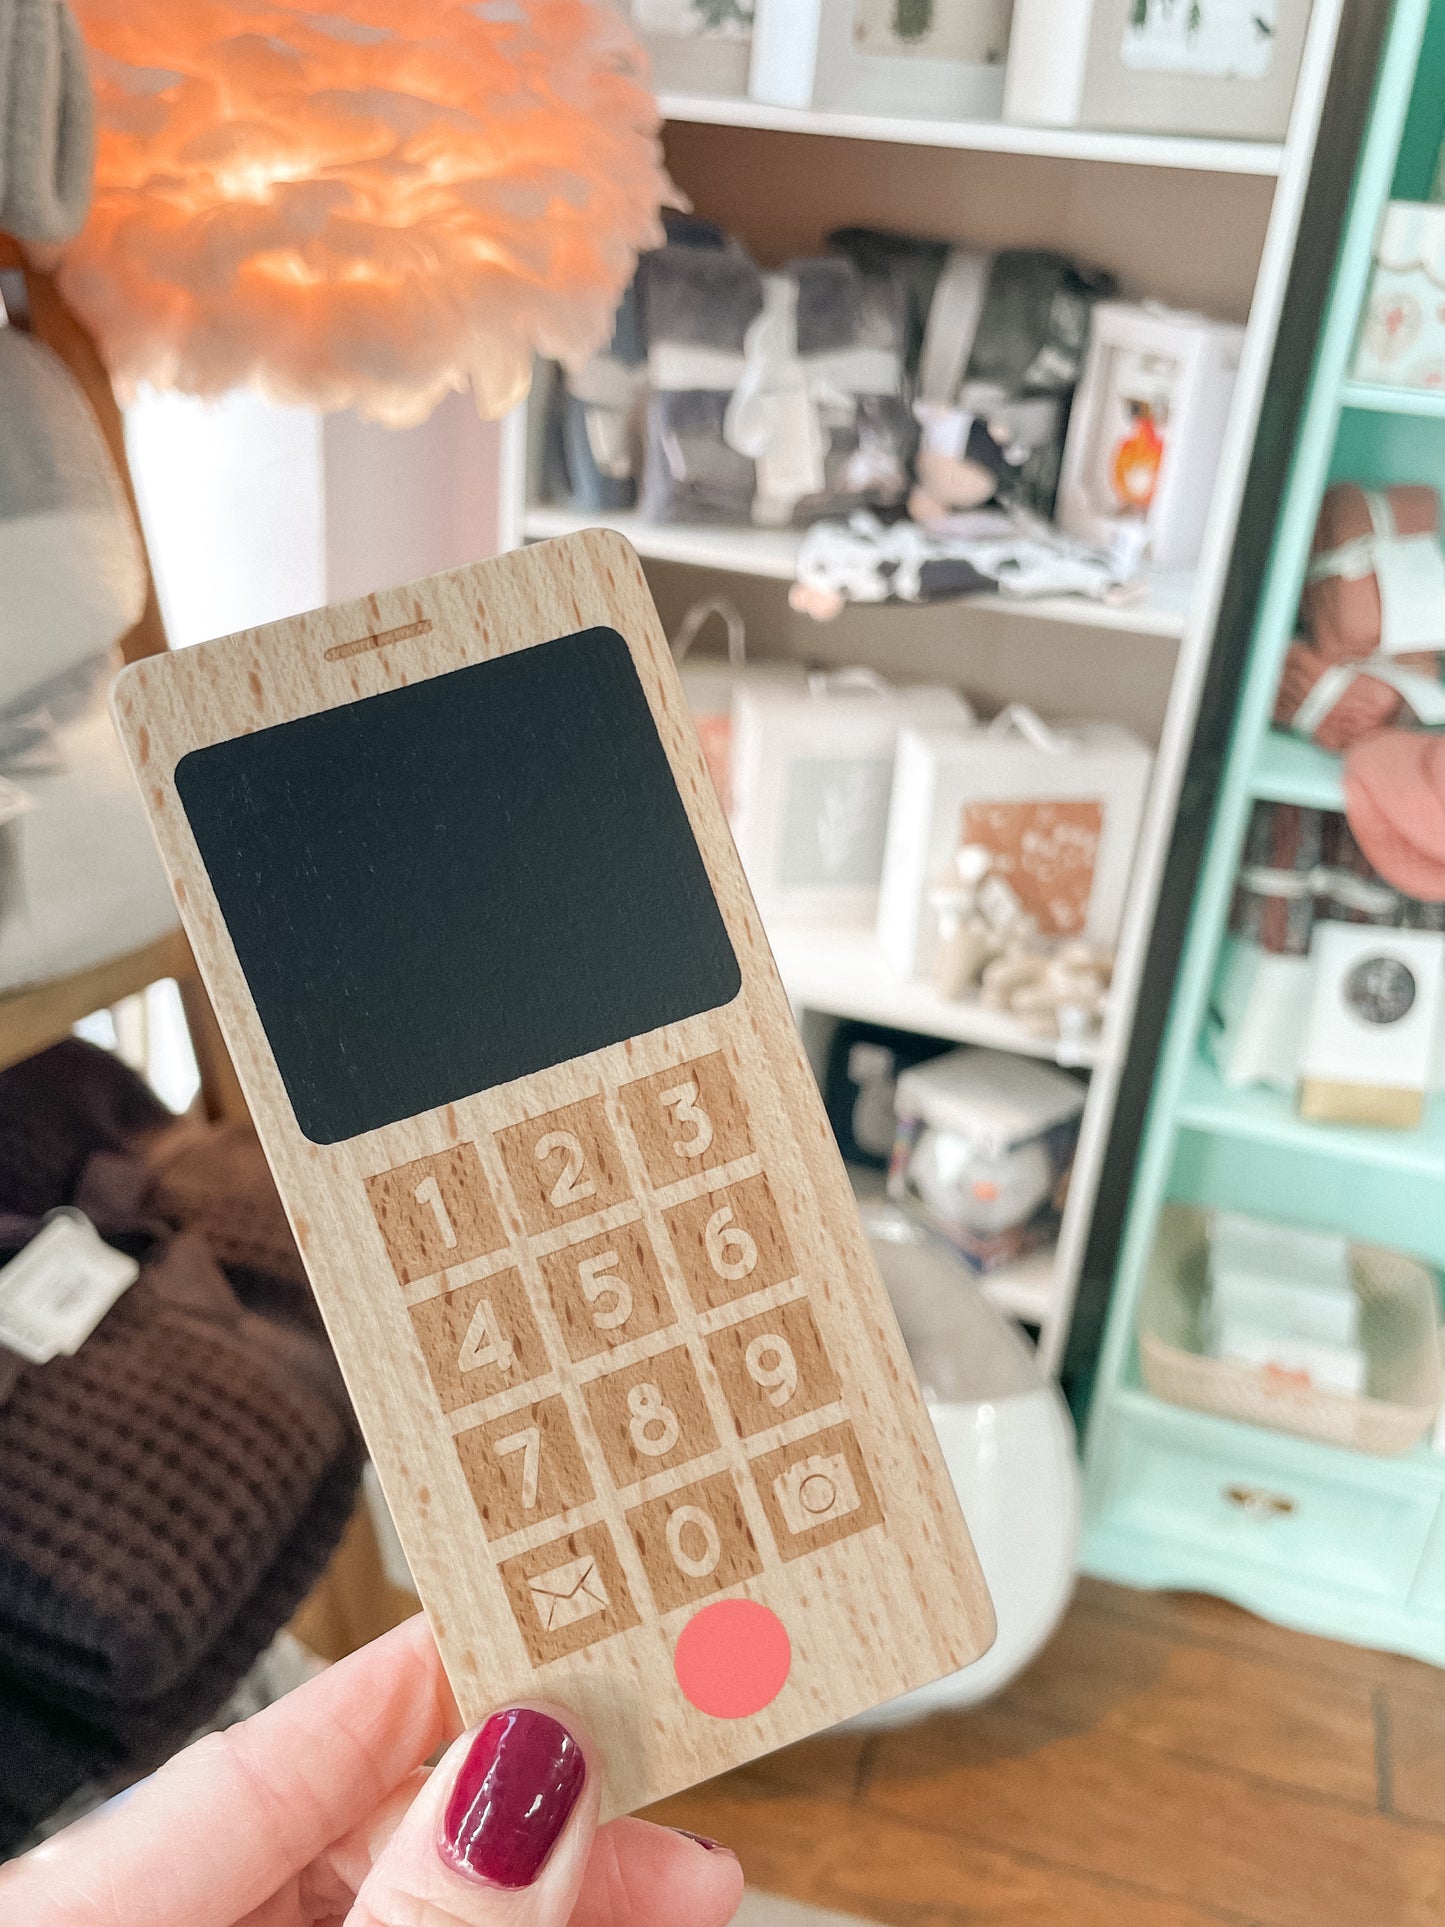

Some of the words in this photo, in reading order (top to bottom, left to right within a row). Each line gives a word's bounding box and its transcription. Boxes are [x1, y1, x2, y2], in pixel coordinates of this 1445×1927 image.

[413, 1176, 458, 1250] 1
[535, 1131, 597, 1208] 2
[659, 1081, 713, 1159] 3
[458, 1299, 513, 1373] 4
[578, 1250, 633, 1330] 5
[704, 1206, 758, 1280] 6
[493, 1427, 541, 1509] 7
[627, 1383, 680, 1456] 8
[745, 1334, 798, 1405] 9
